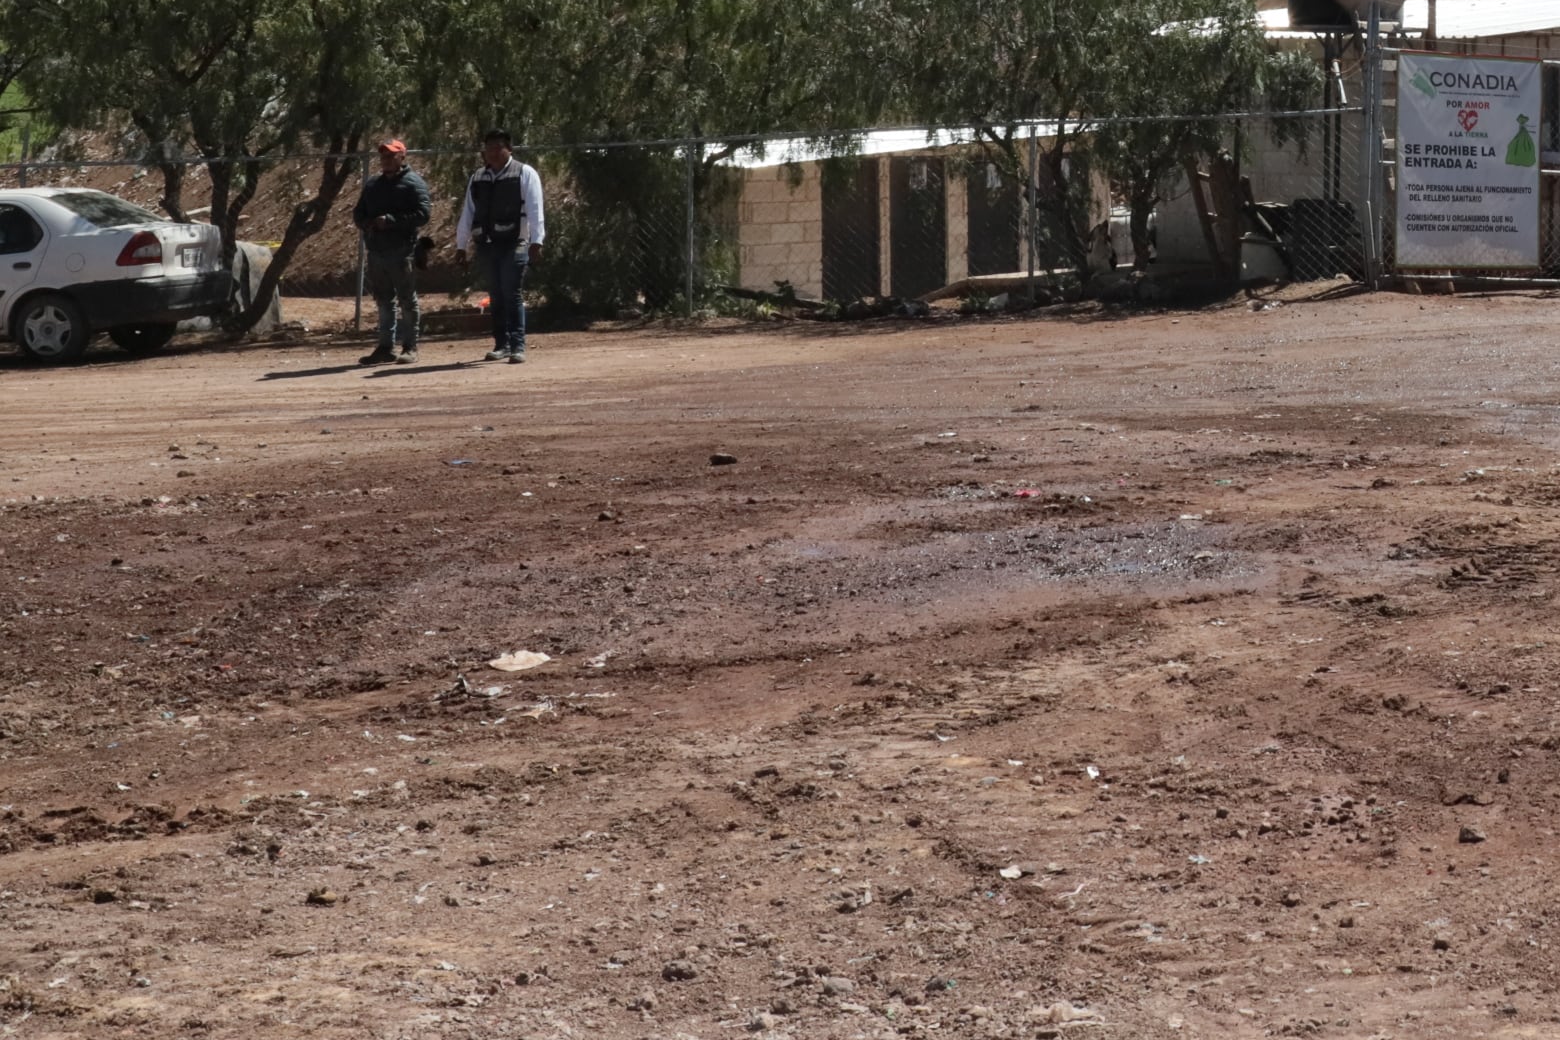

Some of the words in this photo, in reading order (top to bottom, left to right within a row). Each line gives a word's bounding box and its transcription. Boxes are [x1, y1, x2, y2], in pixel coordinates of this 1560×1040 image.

[1430, 72, 1518, 91] CONADIA
[1446, 100, 1462, 108] POR
[1465, 101, 1490, 110] AMOR
[1405, 144, 1420, 154] SE
[1425, 145, 1477, 156] PROHIBE
[1481, 146, 1496, 157] LA
[1405, 157, 1462, 168] ENTRADA
[1465, 159, 1477, 169] A:
[1426, 184, 1453, 192] PERSONA
[1484, 186, 1532, 194] FUNCIONAMIENTO
[1423, 194, 1450, 202] RELLENO
[1452, 195, 1482, 203] SANITARIO
[1452, 215, 1489, 223] ORGANISMOS
[1407, 224, 1435, 232] CUENTEN
[1437, 224, 1449, 232] CON
